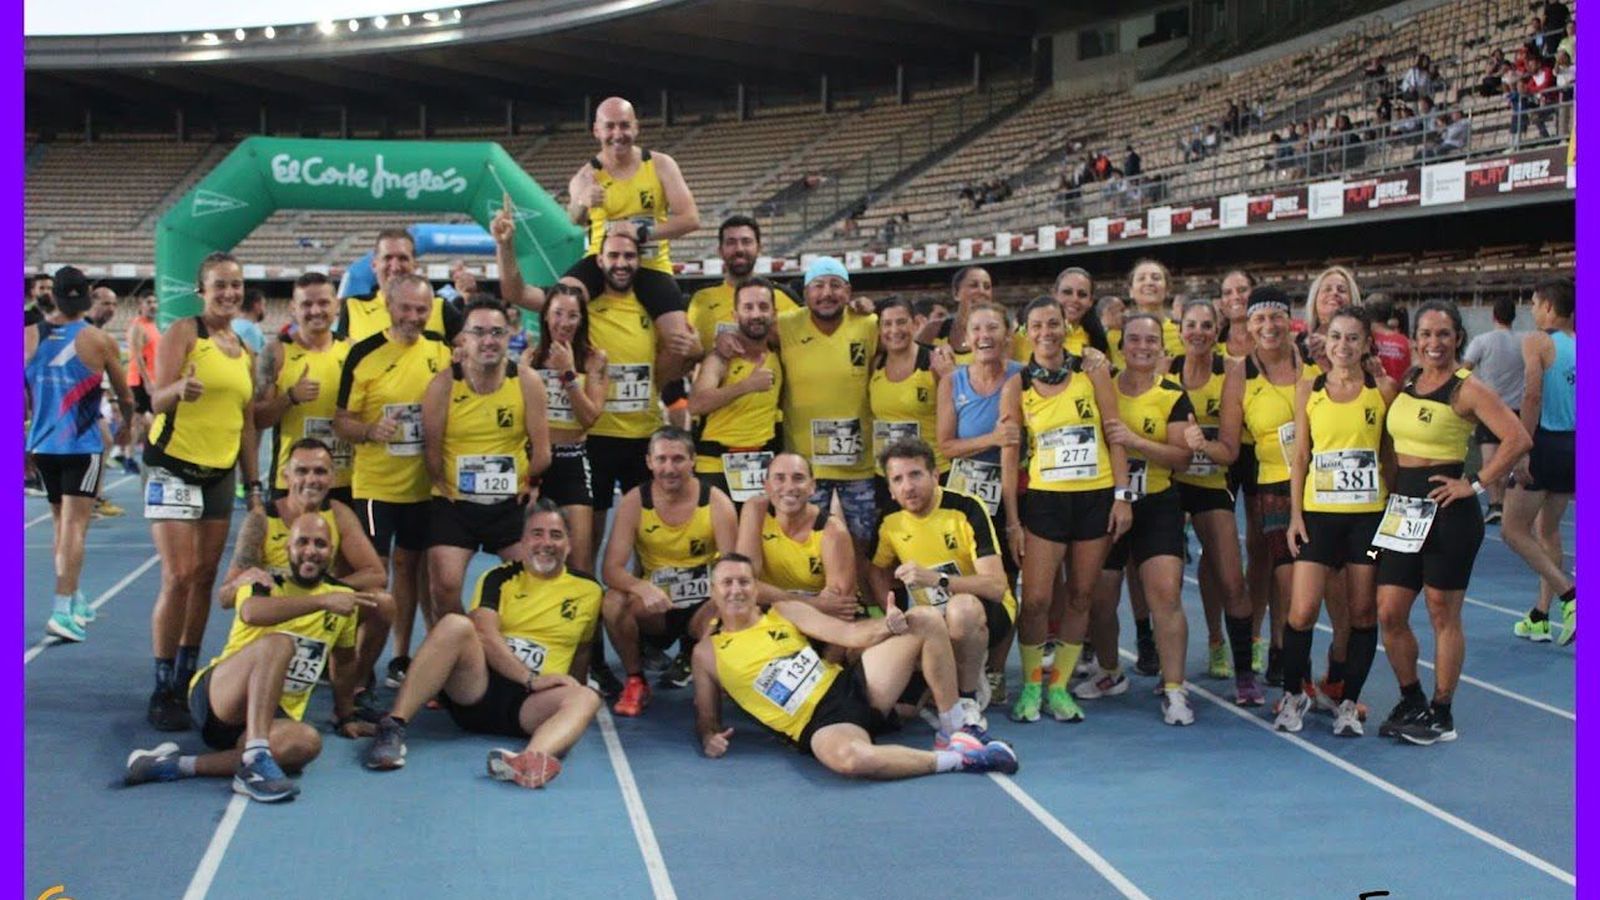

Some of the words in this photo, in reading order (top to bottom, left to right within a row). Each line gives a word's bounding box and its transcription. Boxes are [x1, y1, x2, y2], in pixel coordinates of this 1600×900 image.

[271, 154, 300, 183] El
[302, 157, 368, 188] Corte
[371, 154, 467, 199] Inglés
[1470, 166, 1506, 187] PLAY
[1498, 159, 1551, 192] JEREZ
[622, 383, 649, 398] 417
[1062, 448, 1089, 463] 277
[483, 478, 509, 490] 120
[1337, 469, 1375, 490] 381
[970, 481, 998, 500] 451
[676, 581, 708, 597] 420
[787, 654, 811, 679] 134
